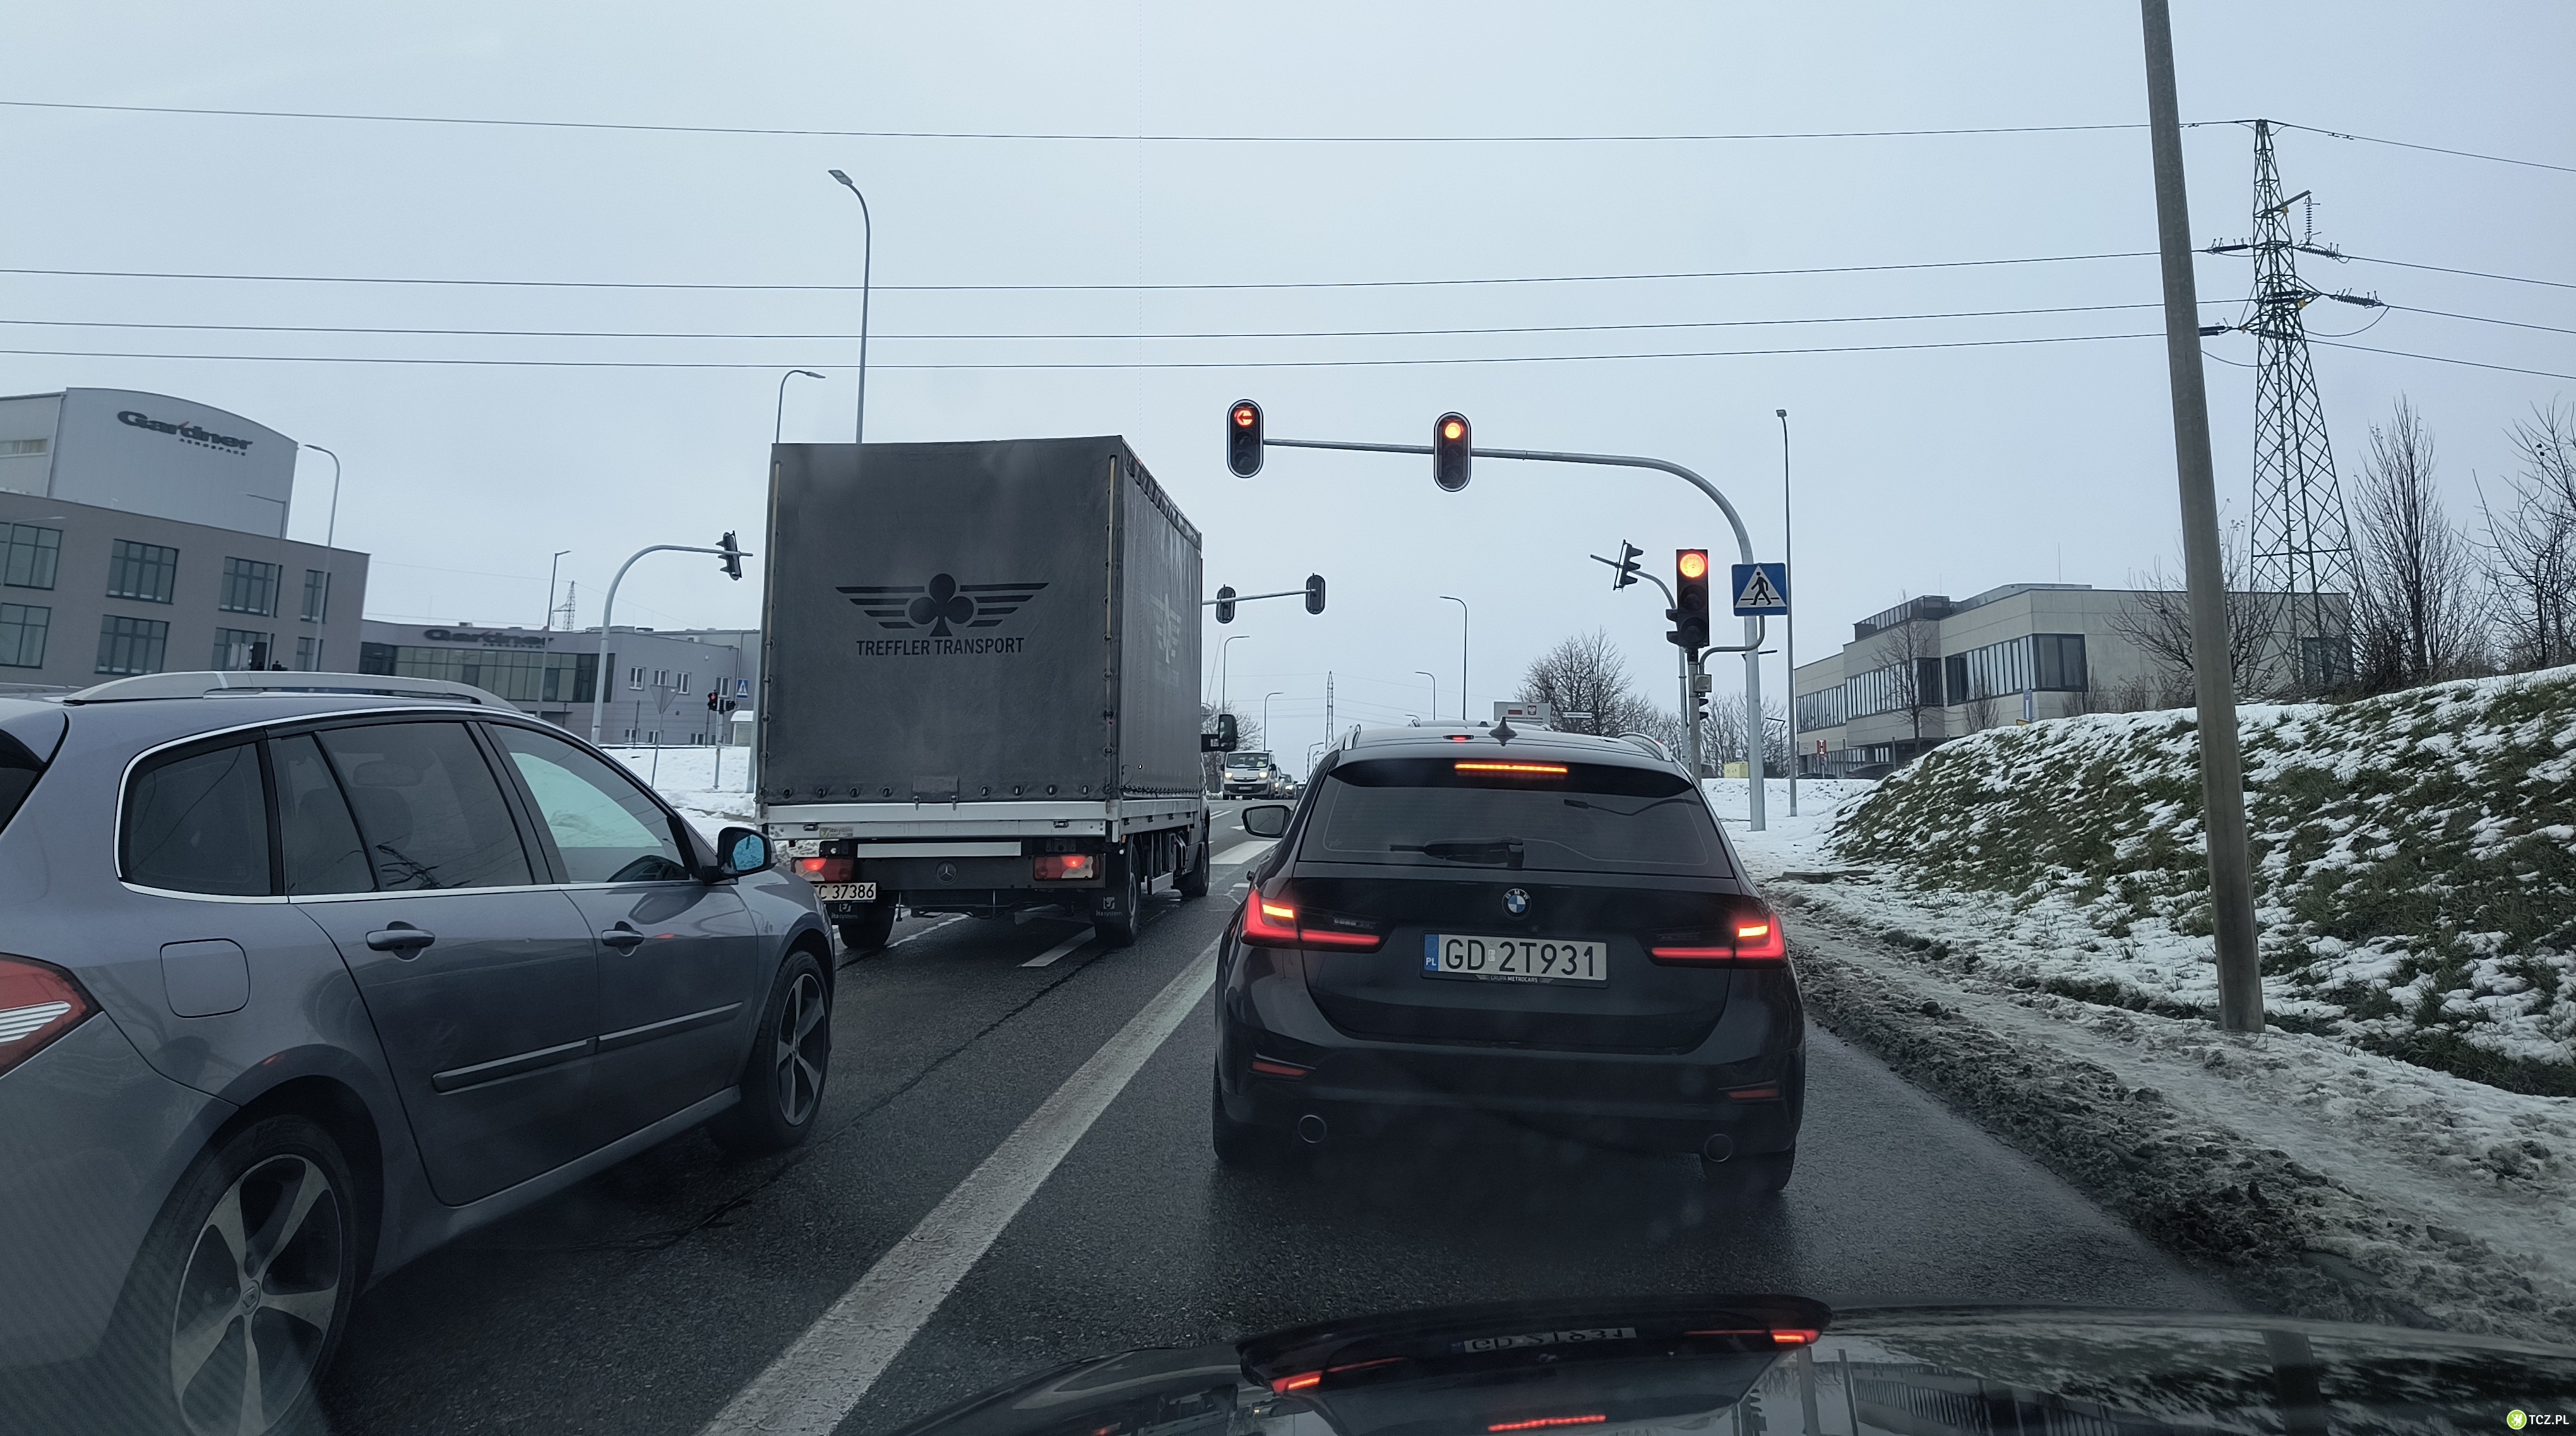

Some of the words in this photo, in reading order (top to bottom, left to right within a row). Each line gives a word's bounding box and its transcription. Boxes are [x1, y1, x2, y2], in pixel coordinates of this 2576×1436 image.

[117, 411, 253, 450] Gardner
[856, 640, 930, 655] TREFFLER
[934, 637, 1024, 654] TRANSPORT
[832, 883, 874, 899] 37386
[1505, 889, 1529, 900] BMW
[1426, 957, 1437, 966] PL
[1445, 938, 1485, 971] GD
[1498, 941, 1594, 977] 2T931
